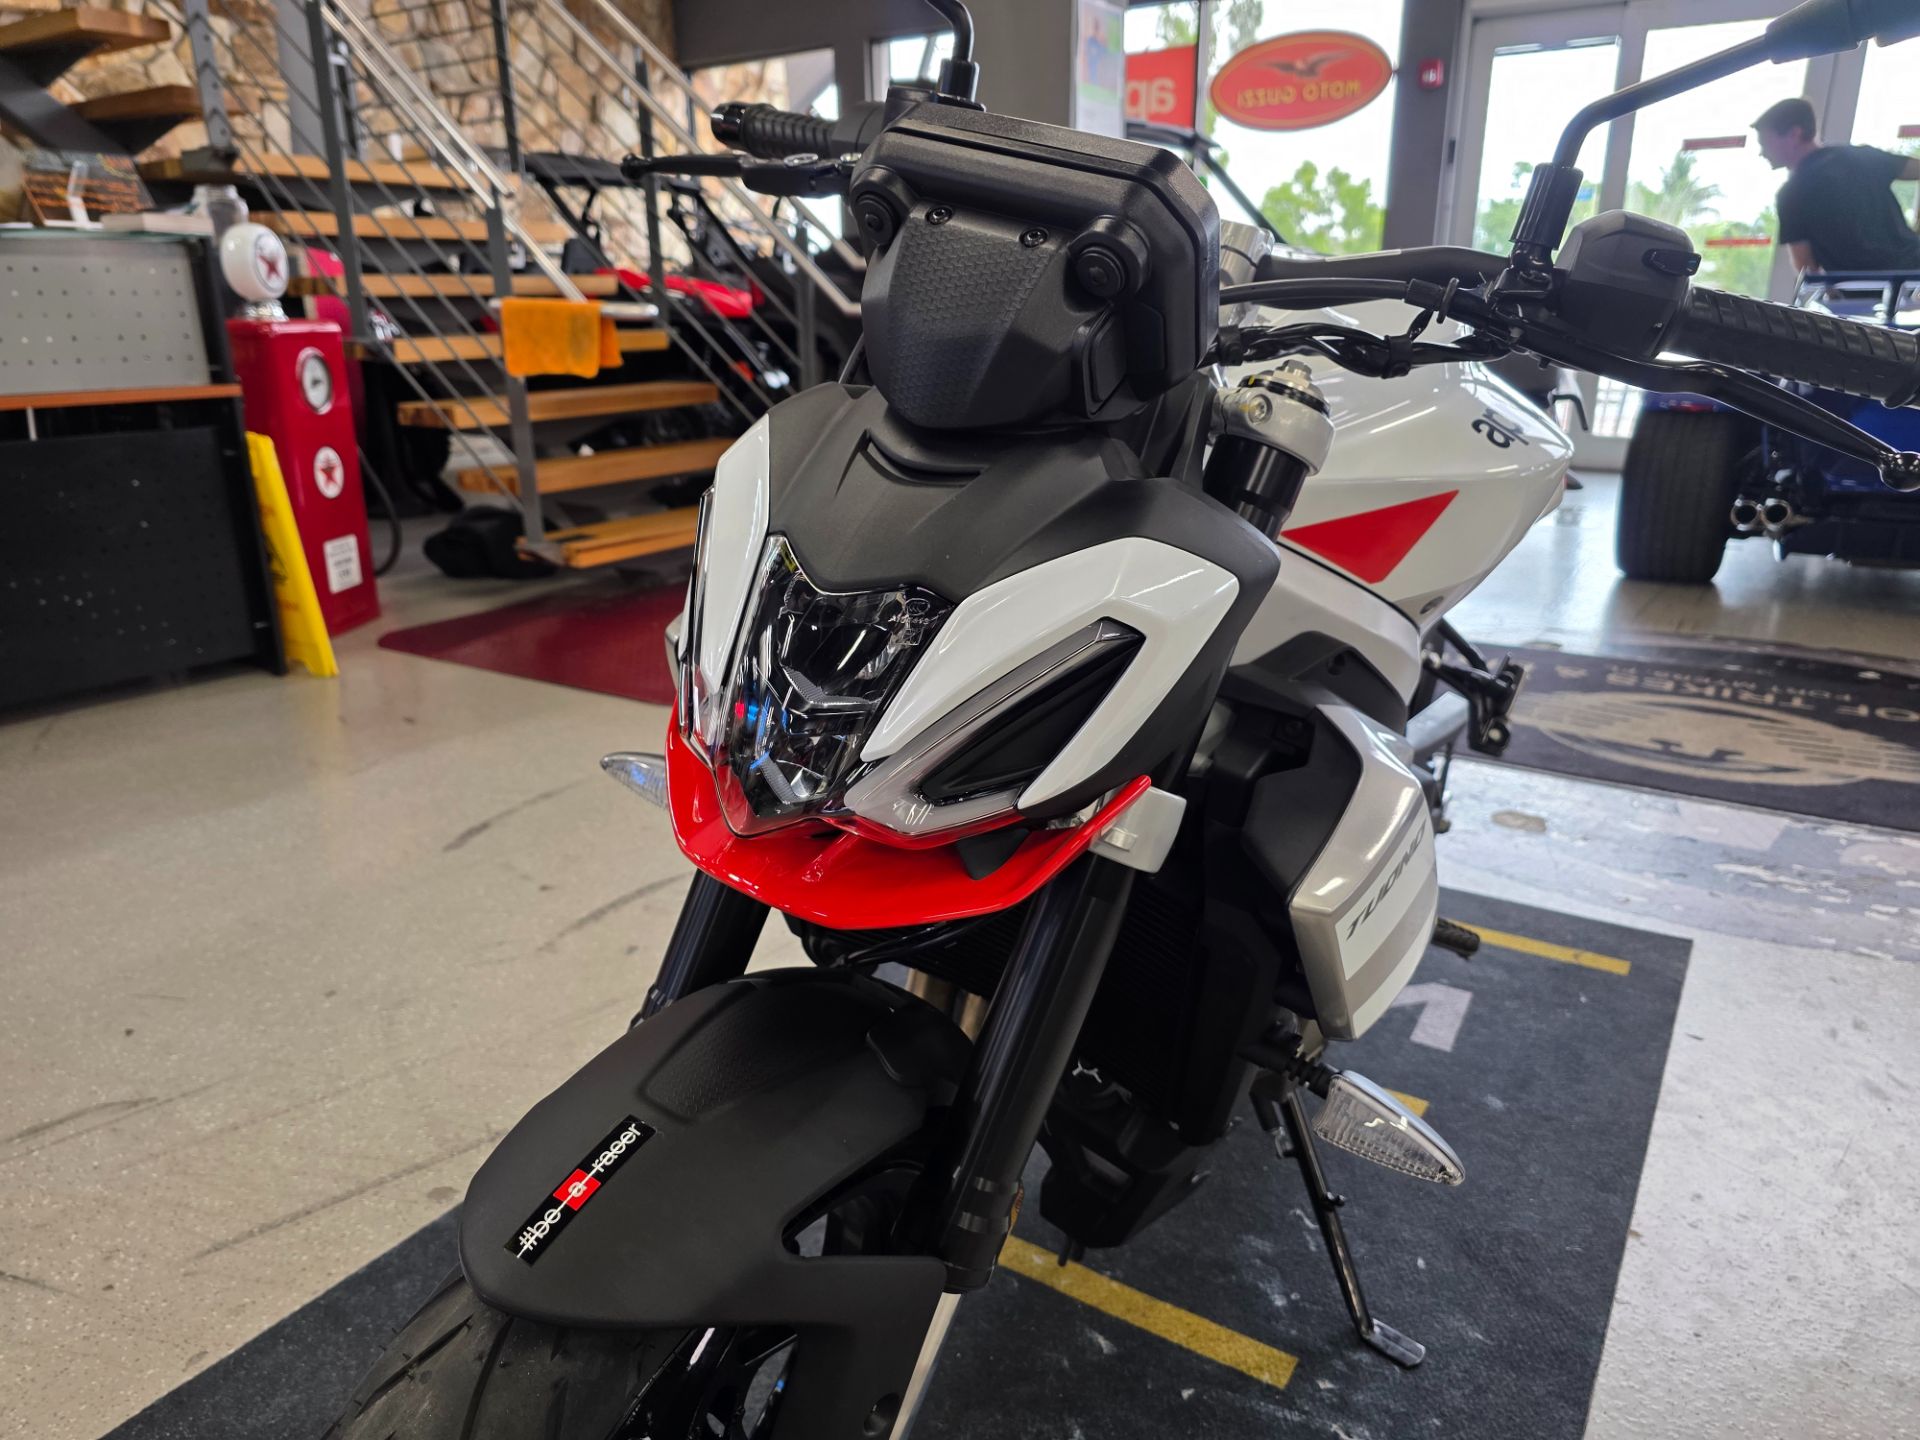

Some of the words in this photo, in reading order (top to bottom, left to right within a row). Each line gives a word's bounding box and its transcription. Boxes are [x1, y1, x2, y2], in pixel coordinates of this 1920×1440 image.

[1605, 671, 1815, 711] TRIKES
[518, 1208, 562, 1252] #be
[567, 1181, 588, 1198] a
[591, 1123, 642, 1173] racer
